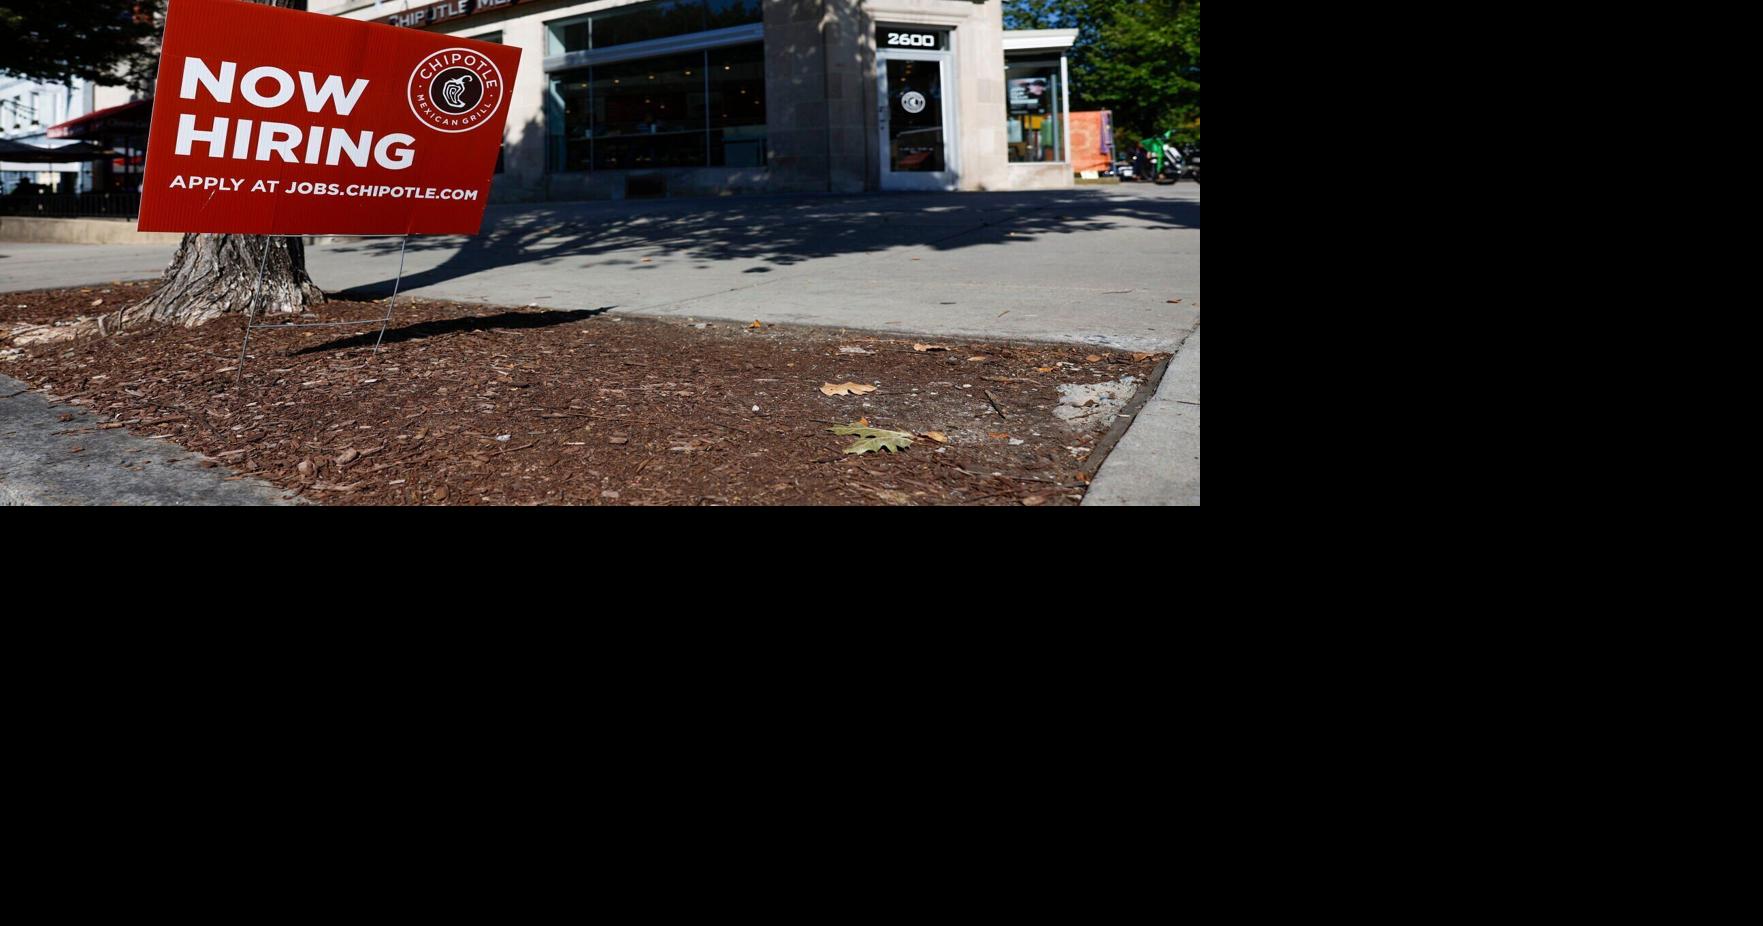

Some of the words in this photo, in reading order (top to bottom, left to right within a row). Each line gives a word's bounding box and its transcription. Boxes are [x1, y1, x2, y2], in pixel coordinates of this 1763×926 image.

[888, 33, 934, 47] 2600
[180, 57, 369, 115] NOW
[420, 53, 498, 88] CHIPOTLE
[416, 94, 458, 126] MEXICAN
[462, 102, 492, 125] GRILL
[174, 114, 415, 169] HIRING
[170, 176, 244, 191] APPLY
[251, 180, 279, 193] AT
[285, 182, 478, 201] JOBS.CHIPOTLE.COM
